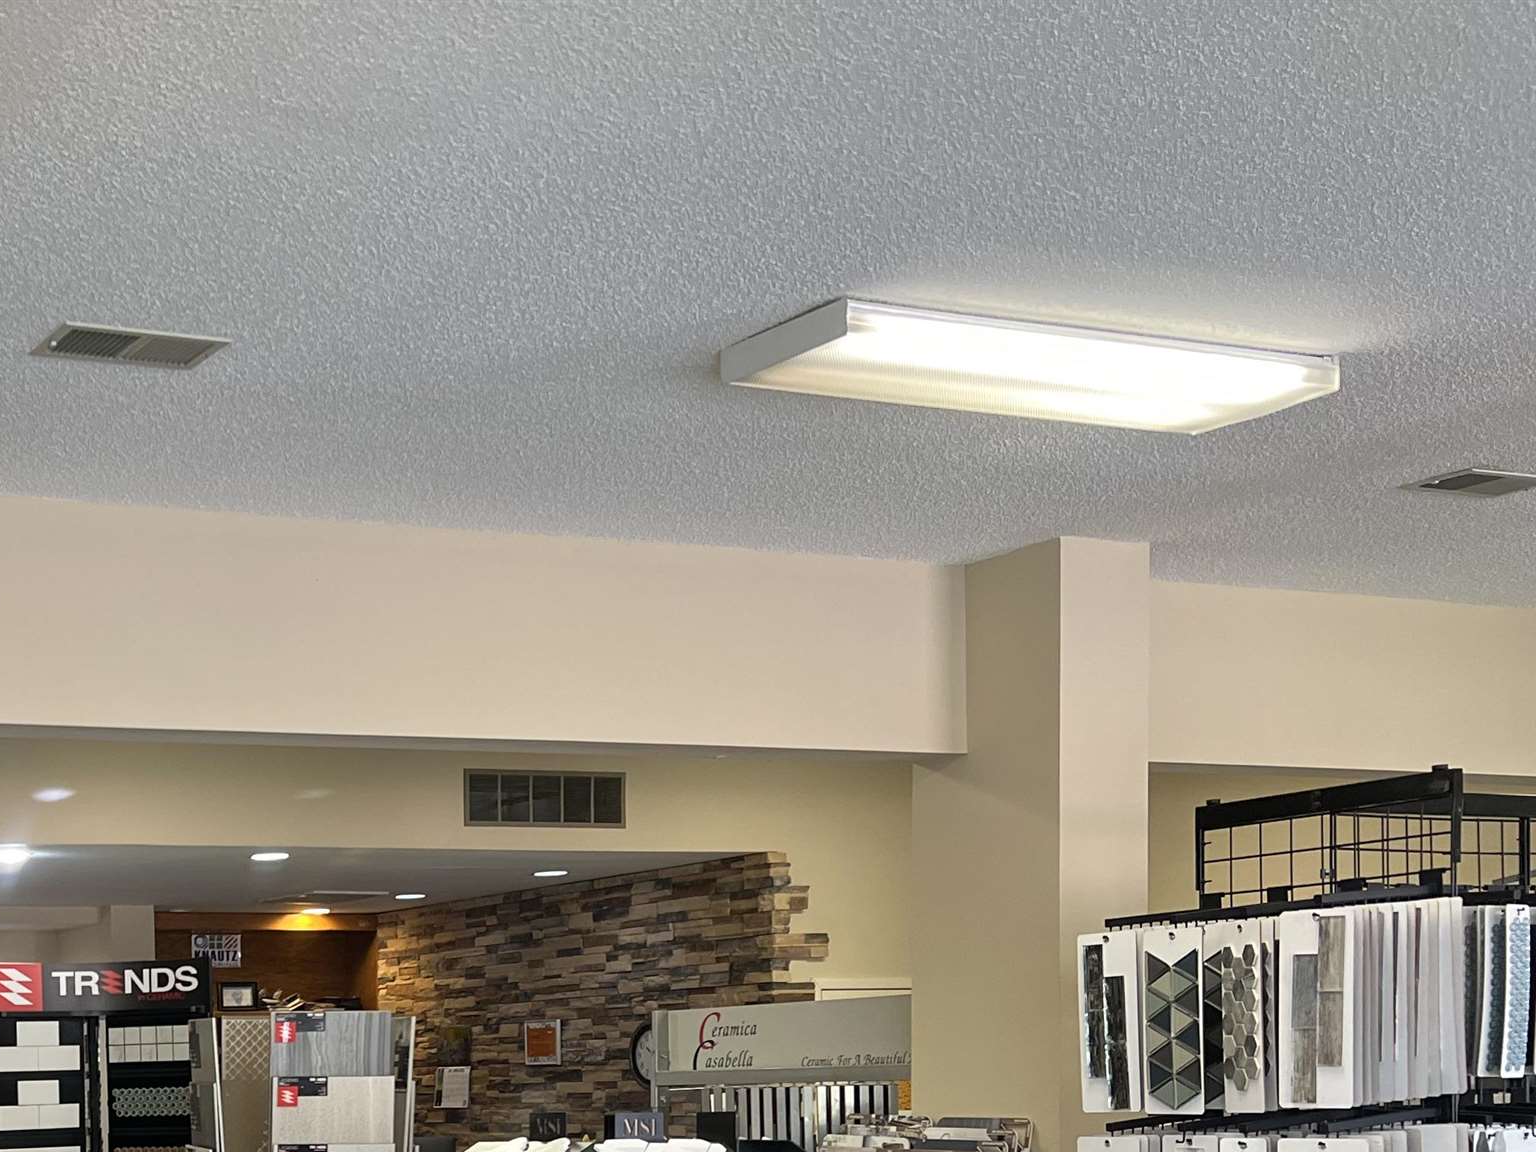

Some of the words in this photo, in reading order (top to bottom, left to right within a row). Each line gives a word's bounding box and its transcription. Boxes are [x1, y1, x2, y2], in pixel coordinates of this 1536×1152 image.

[51, 965, 199, 996] TRENDS
[699, 1011, 757, 1049] Ceramica
[837, 1054, 851, 1066] For
[852, 1054, 861, 1066] A
[864, 1050, 907, 1066] Beautiful
[624, 1118, 657, 1137] MSI
